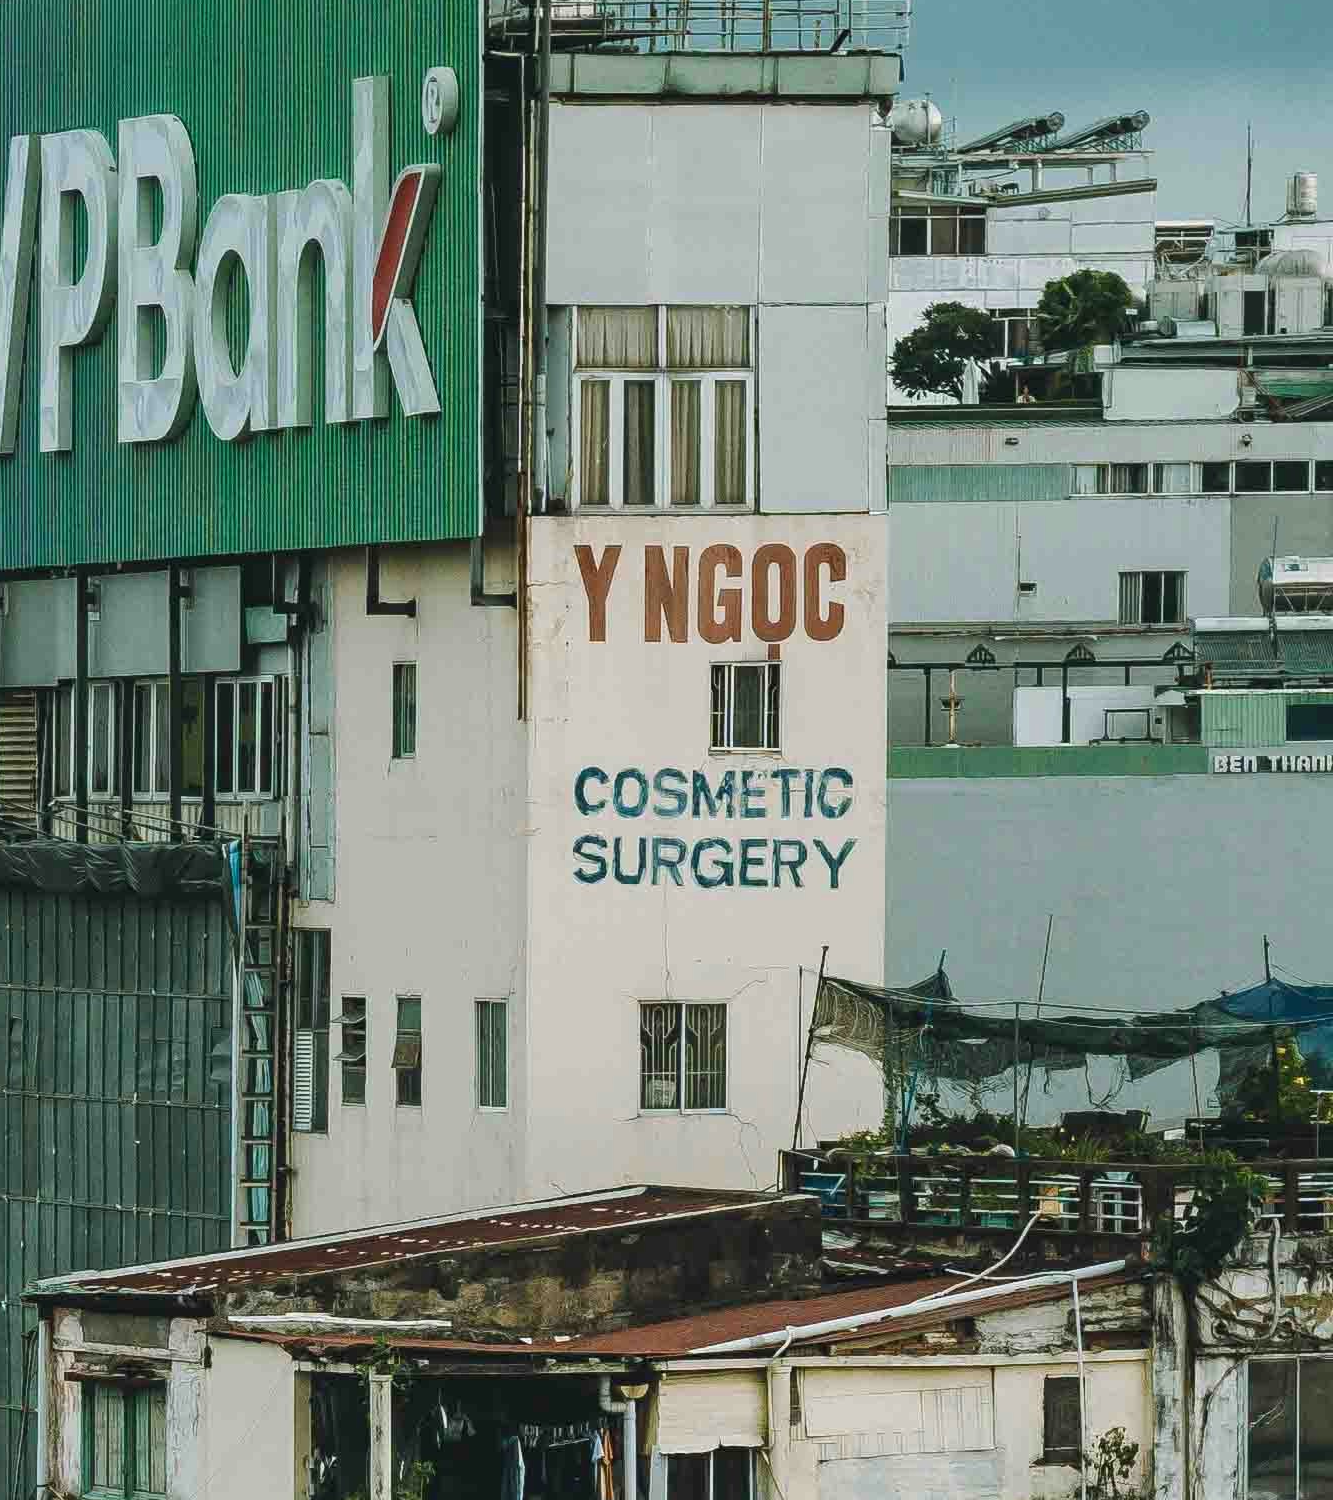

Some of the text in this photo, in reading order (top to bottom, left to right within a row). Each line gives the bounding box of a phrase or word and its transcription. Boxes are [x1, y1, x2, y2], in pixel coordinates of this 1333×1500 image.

[573, 543, 623, 644] Y
[1213, 754, 1259, 773] BEN
[573, 766, 855, 820] COSMETIC
[572, 834, 858, 889] SURGERY
